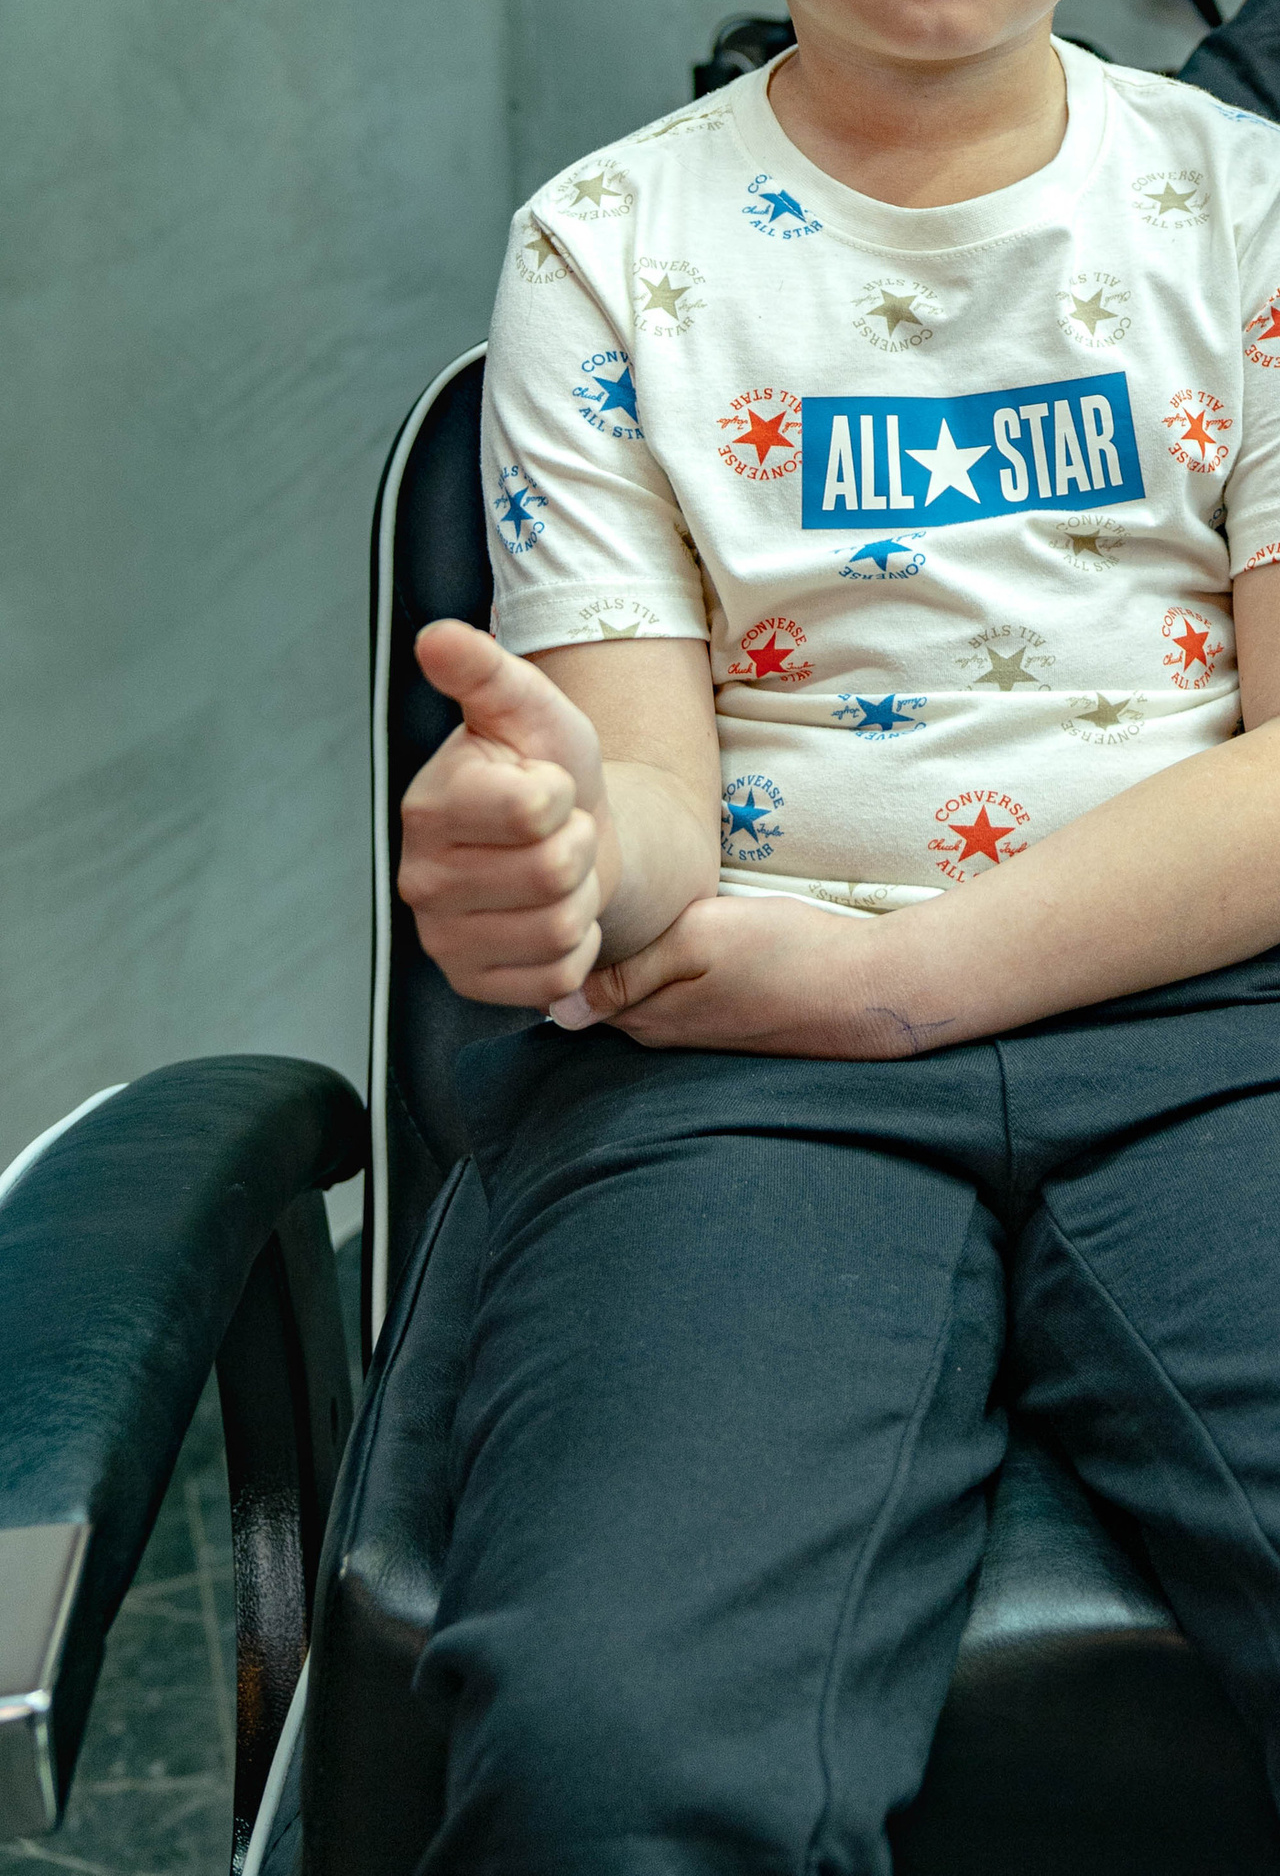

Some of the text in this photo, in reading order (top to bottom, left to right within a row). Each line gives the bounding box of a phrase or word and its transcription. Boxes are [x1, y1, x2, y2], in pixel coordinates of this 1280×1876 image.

[1131, 170, 1204, 192] CONVERSE
[750, 218, 823, 240] ALL STAR
[654, 316, 695, 338] STAR
[852, 317, 933, 352] CONVERSE
[730, 388, 773, 411] STAR
[1170, 389, 1224, 412] ALL STAR
[579, 406, 645, 440] ALL STA
[718, 444, 802, 481] CONVERSE
[820, 393, 1124, 511] ALL STAR
[579, 597, 660, 625] ALL STAR
[741, 617, 807, 650] CONVERSE
[968, 624, 1047, 649] ALL STAR
[728, 662, 754, 675] Chuck
[1170, 671, 1191, 690] ALL
[935, 790, 1031, 826] CONVERSE
[738, 842, 775, 862] STAR
[927, 838, 1030, 858] Chuck Tayl
[935, 858, 965, 883] ALL
